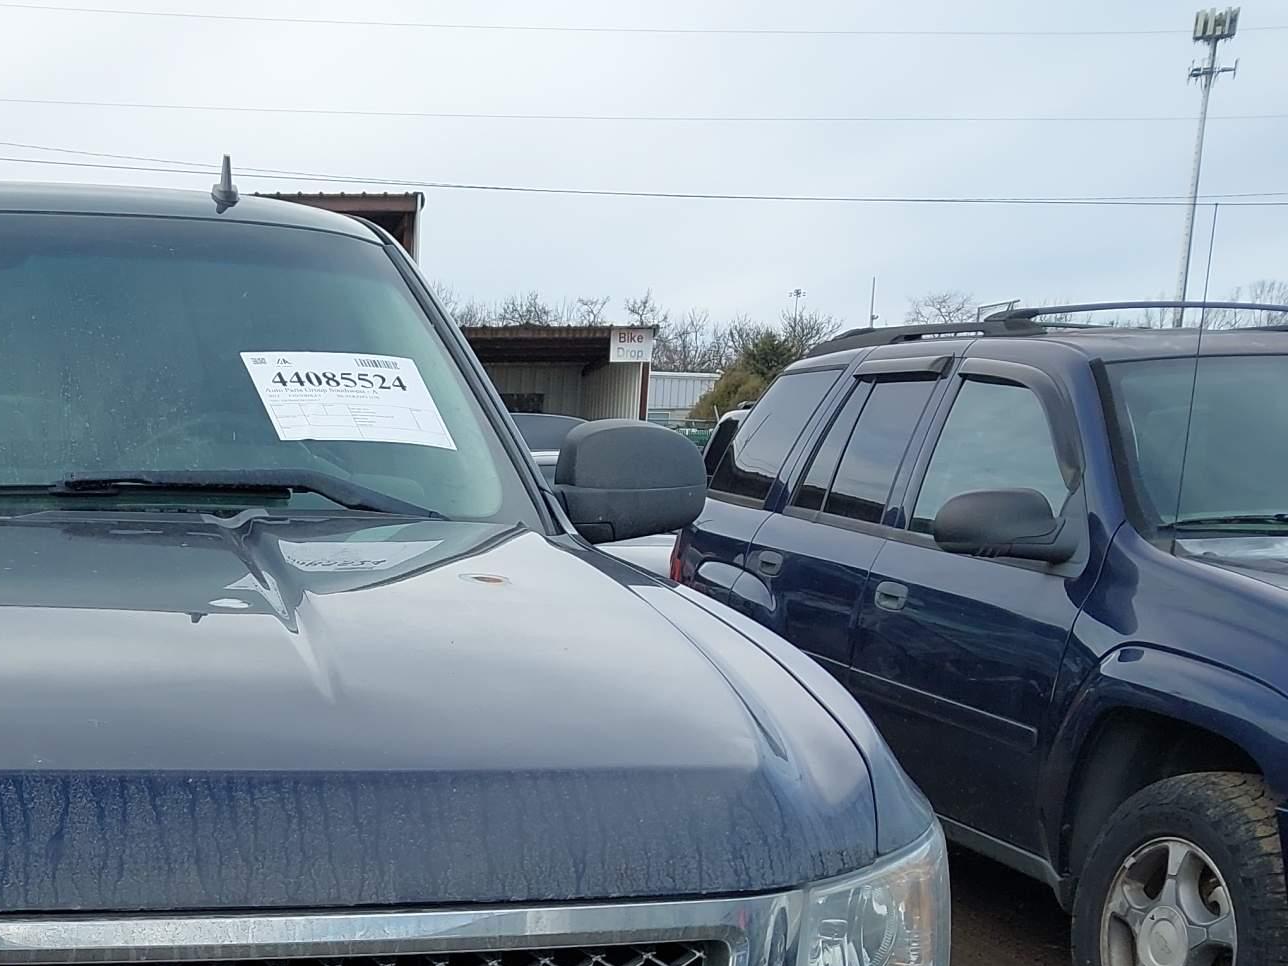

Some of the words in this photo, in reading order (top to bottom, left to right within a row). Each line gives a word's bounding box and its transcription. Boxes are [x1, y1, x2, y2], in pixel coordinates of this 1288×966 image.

[618, 332, 644, 344] Bike
[617, 347, 644, 360] Drop
[271, 371, 408, 392] 44085524
